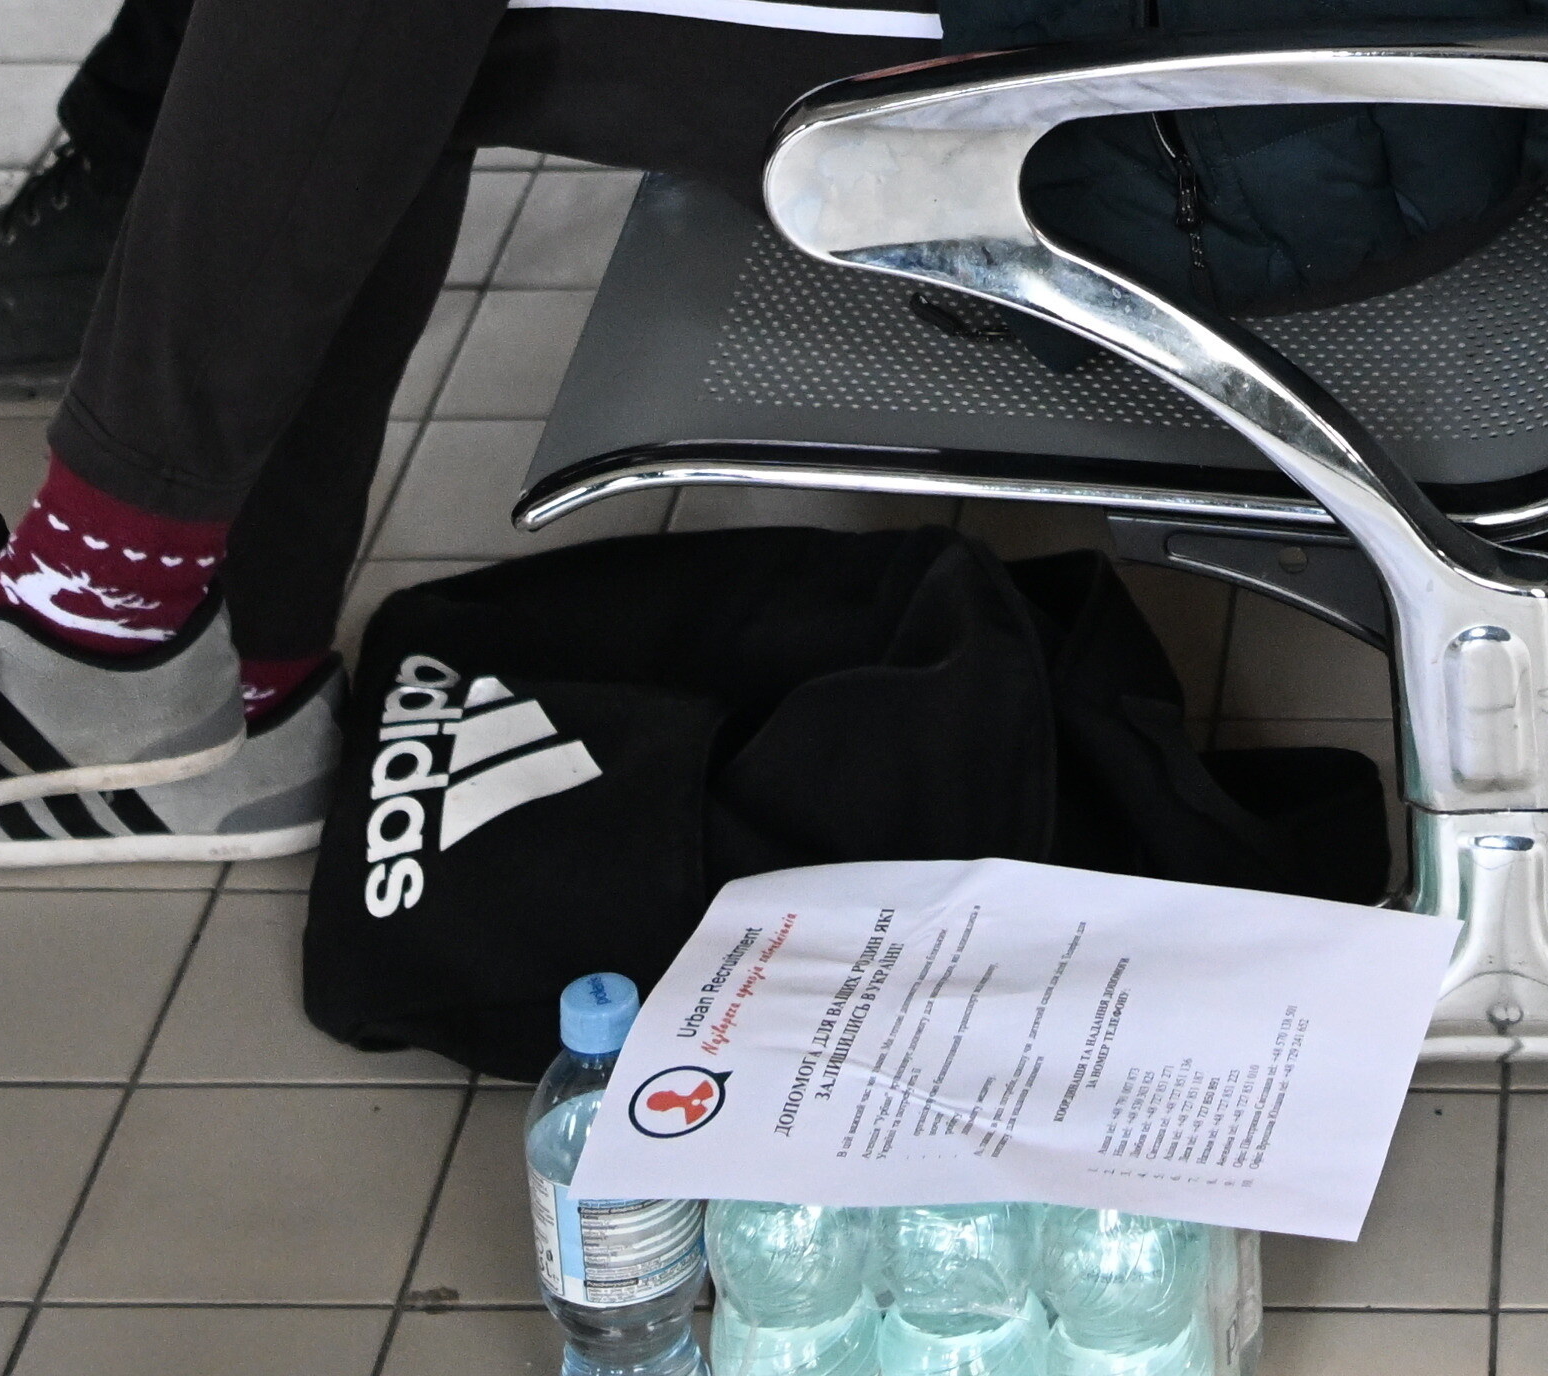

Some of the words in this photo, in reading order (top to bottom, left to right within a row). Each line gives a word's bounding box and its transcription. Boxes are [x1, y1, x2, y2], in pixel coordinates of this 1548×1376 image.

[363, 653, 464, 919] adidas
[676, 997, 714, 1037] Urban
[700, 927, 763, 992] Recruitment
[773, 1051, 823, 1137] ДОПОМОГА
[812, 1019, 837, 1047] ДЛЯ
[826, 976, 862, 1016] ВАШИХ
[851, 936, 884, 973] РОДИН
[873, 908, 895, 932] ЯКІ
[814, 1003, 871, 1100] ЗАЛИШИЛИСЬ
[860, 992, 877, 1001] В
